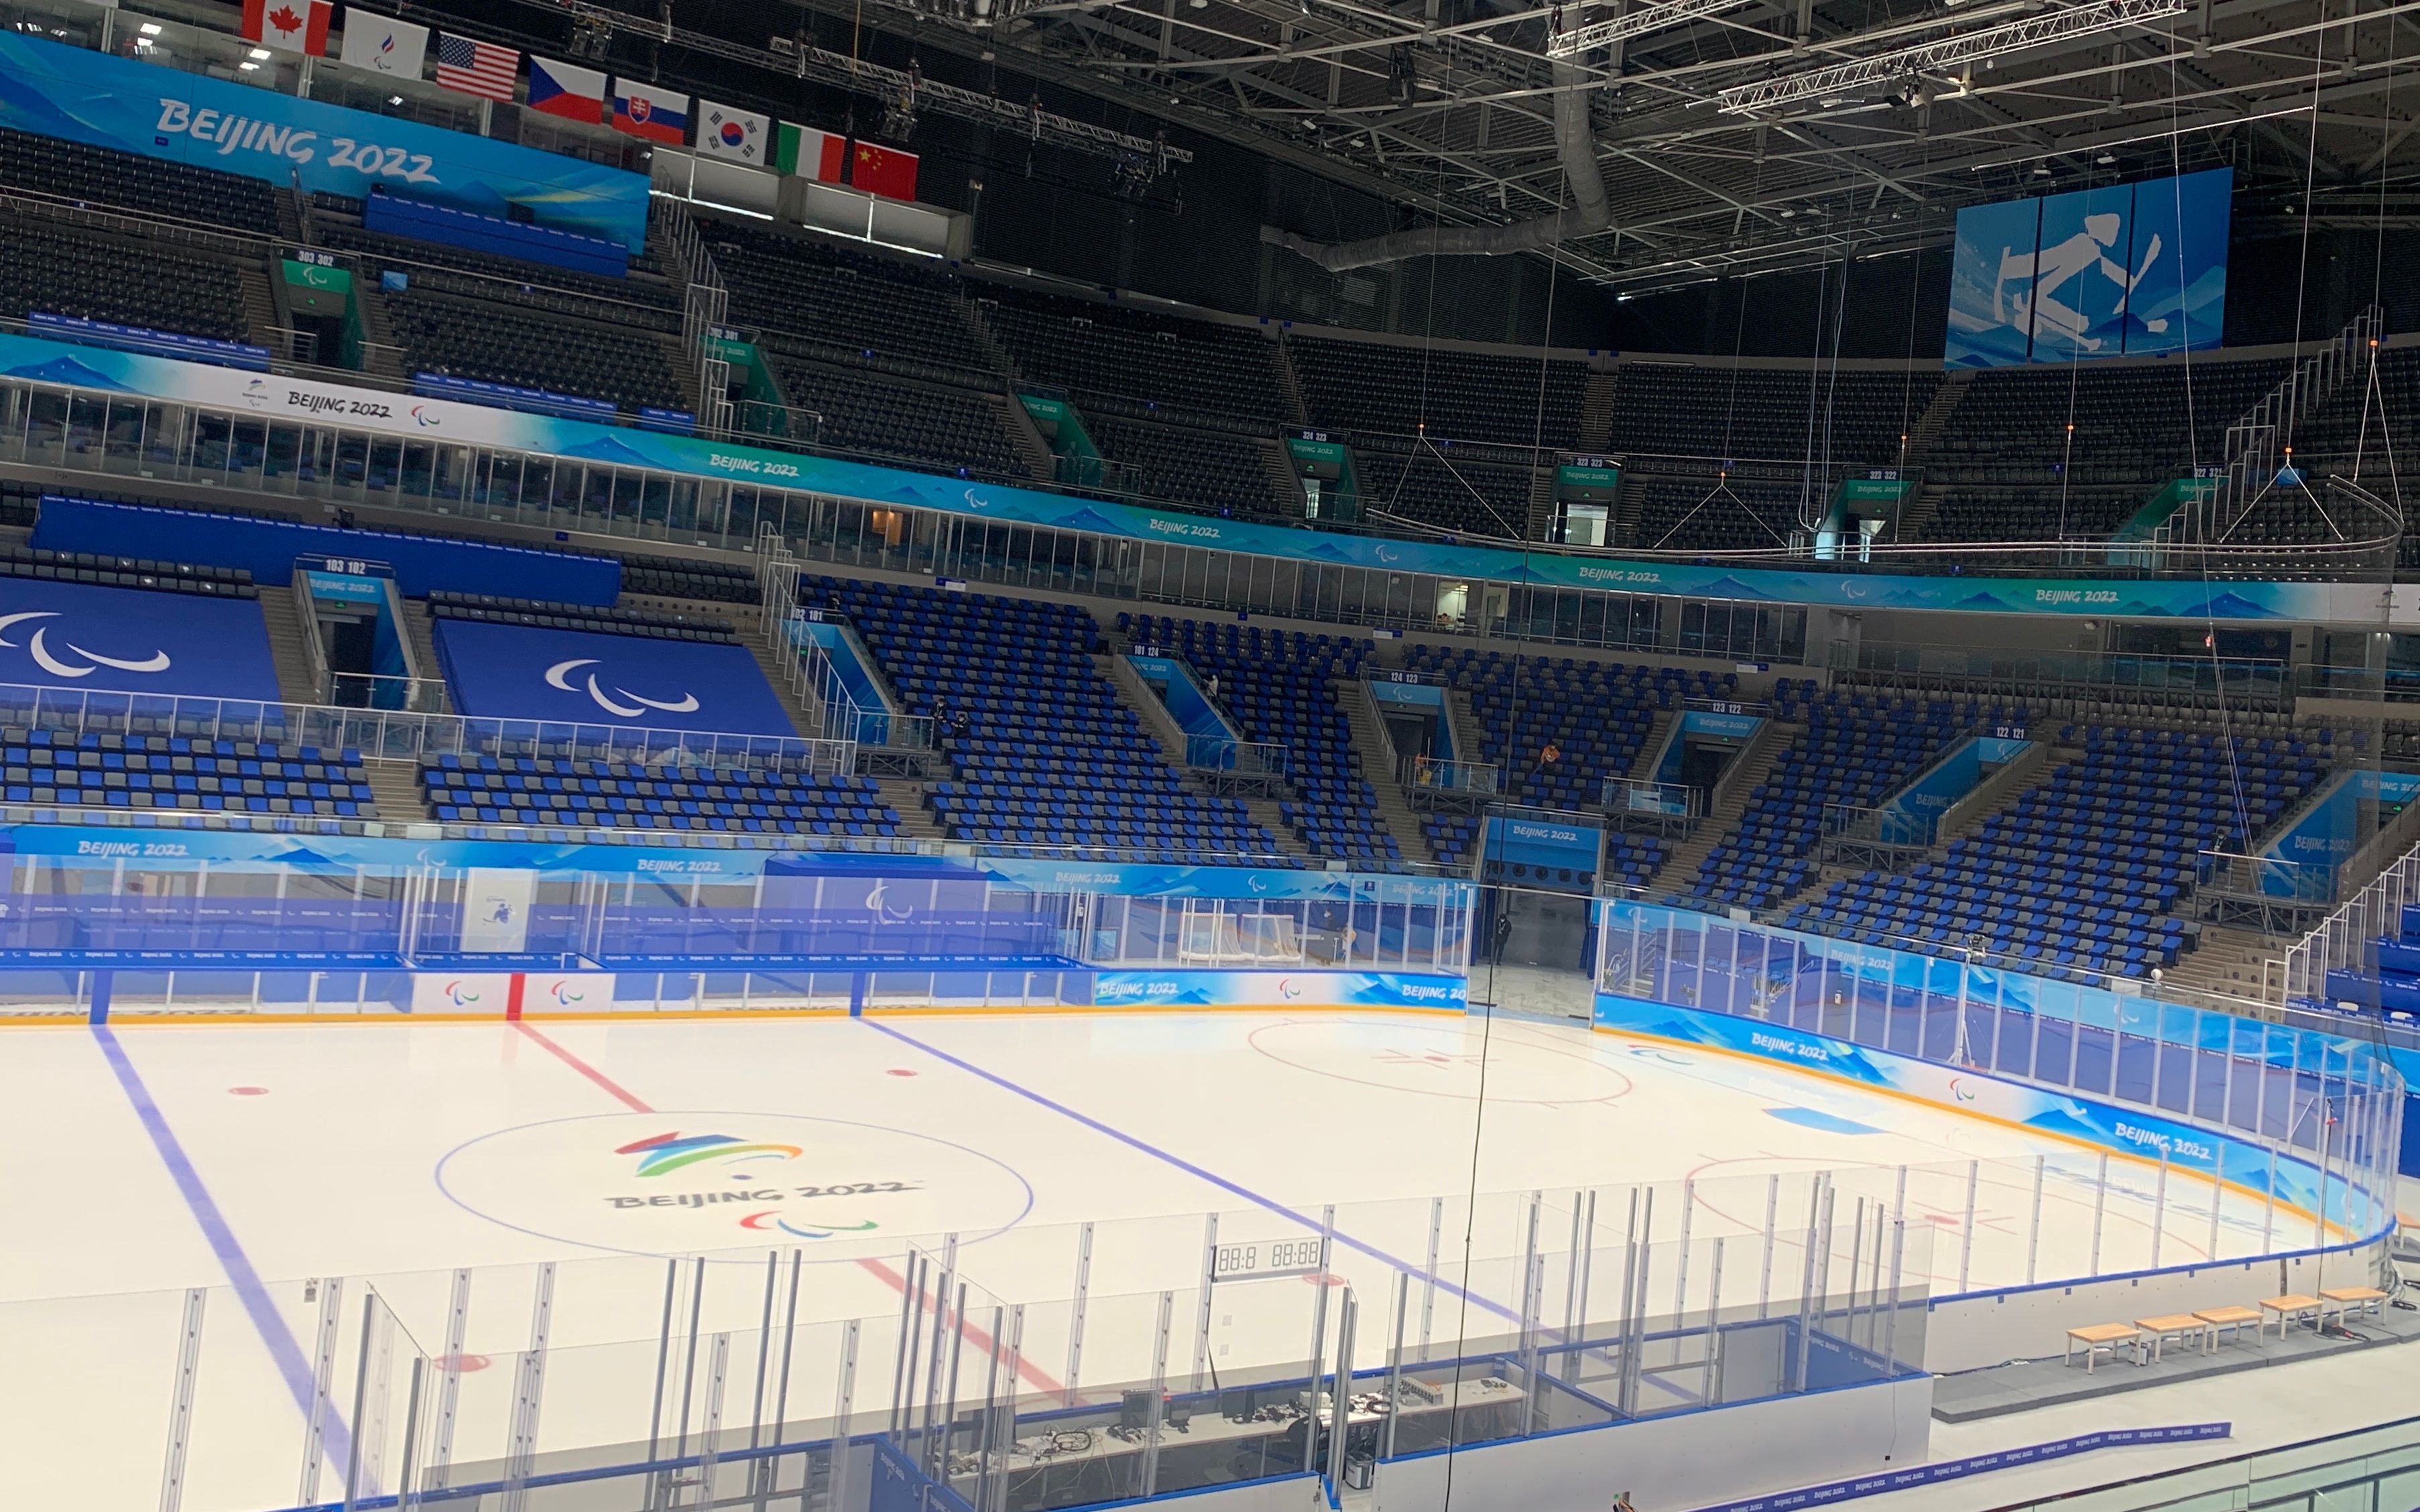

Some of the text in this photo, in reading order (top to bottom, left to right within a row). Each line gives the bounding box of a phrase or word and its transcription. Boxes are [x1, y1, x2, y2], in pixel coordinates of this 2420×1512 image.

[157, 99, 442, 184] BEIJING 2022
[298, 251, 334, 267] 303 302
[288, 391, 346, 414] BEIJING
[350, 401, 393, 418] 2022
[1303, 431, 1327, 442] 324 323
[710, 453, 800, 477] BEIJING 2022
[1577, 458, 1602, 468] 323 323
[1870, 470, 1896, 480] 323 322
[1150, 518, 1221, 538] BEIJING 2022
[326, 559, 366, 575] 103 102
[1579, 566, 1662, 583] BEIJING 2022
[2035, 589, 2120, 605] BEIJING 2022
[809, 610, 823, 621] 101
[1134, 645, 1159, 657] 101 124
[1391, 672, 1418, 684] 124 123
[1713, 702, 1742, 714] 123 122
[1997, 727, 2024, 739] 122 121
[1513, 825, 1579, 841] BEIJING 2022
[78, 840, 190, 859] BEIJING 2022
[2295, 835, 2326, 854] BEIJING
[638, 859, 722, 874] BEIJING 2022
[1055, 871, 1122, 885] BEIJING 2022
[1831, 949, 1893, 970] BEIJING 2022
[1099, 983, 1180, 999] BEIJING 2022
[1402, 984, 1447, 1001] BEIJING
[1752, 1032, 1830, 1062] BEIJING 2022
[2115, 1122, 2214, 1161] BEIJING 2022
[603, 1180, 923, 1209] BEIJING 2022
